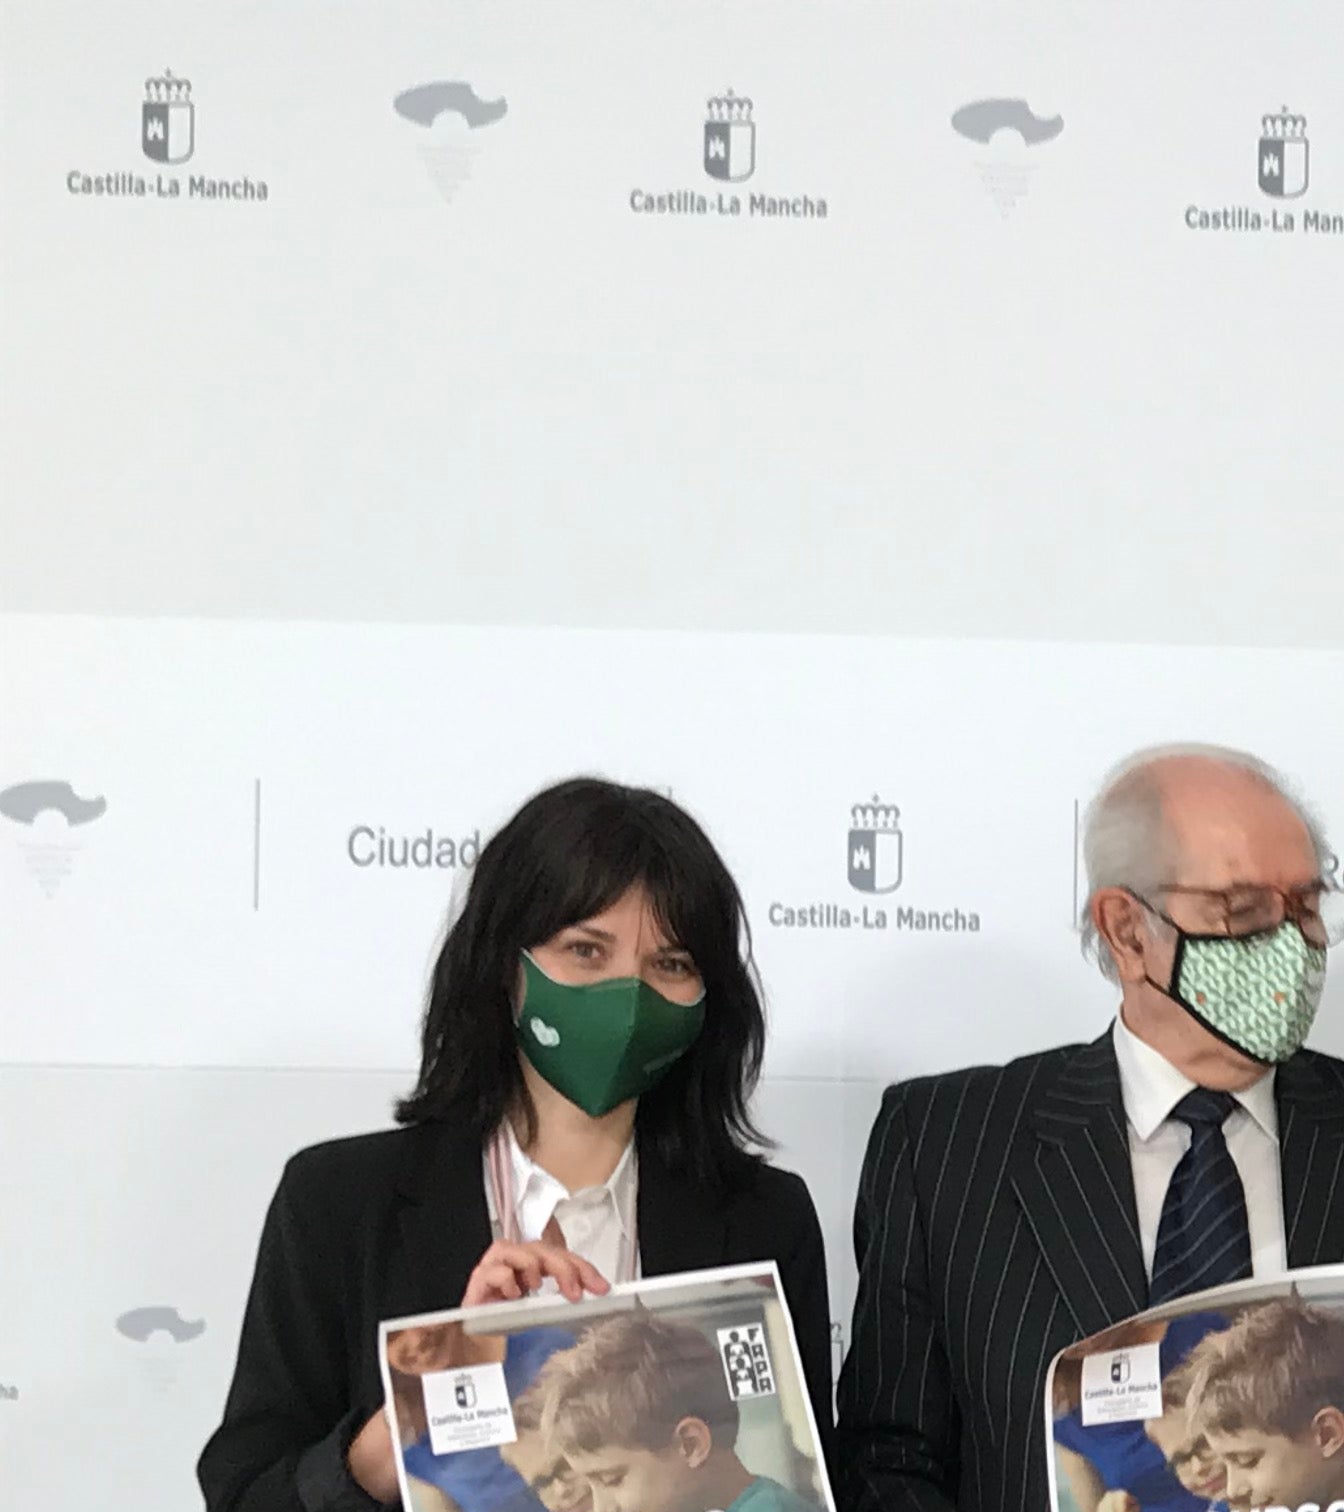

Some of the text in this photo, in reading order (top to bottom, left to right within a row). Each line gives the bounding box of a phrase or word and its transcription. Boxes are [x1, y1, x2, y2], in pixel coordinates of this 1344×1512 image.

[66, 170, 269, 203] Castilla-La Mancha
[629, 189, 828, 218] Castilla-La Mancha
[1183, 205, 1295, 234] Castilla-La
[347, 825, 480, 870] Ciudad
[768, 900, 981, 934] Castilla-La Mancha
